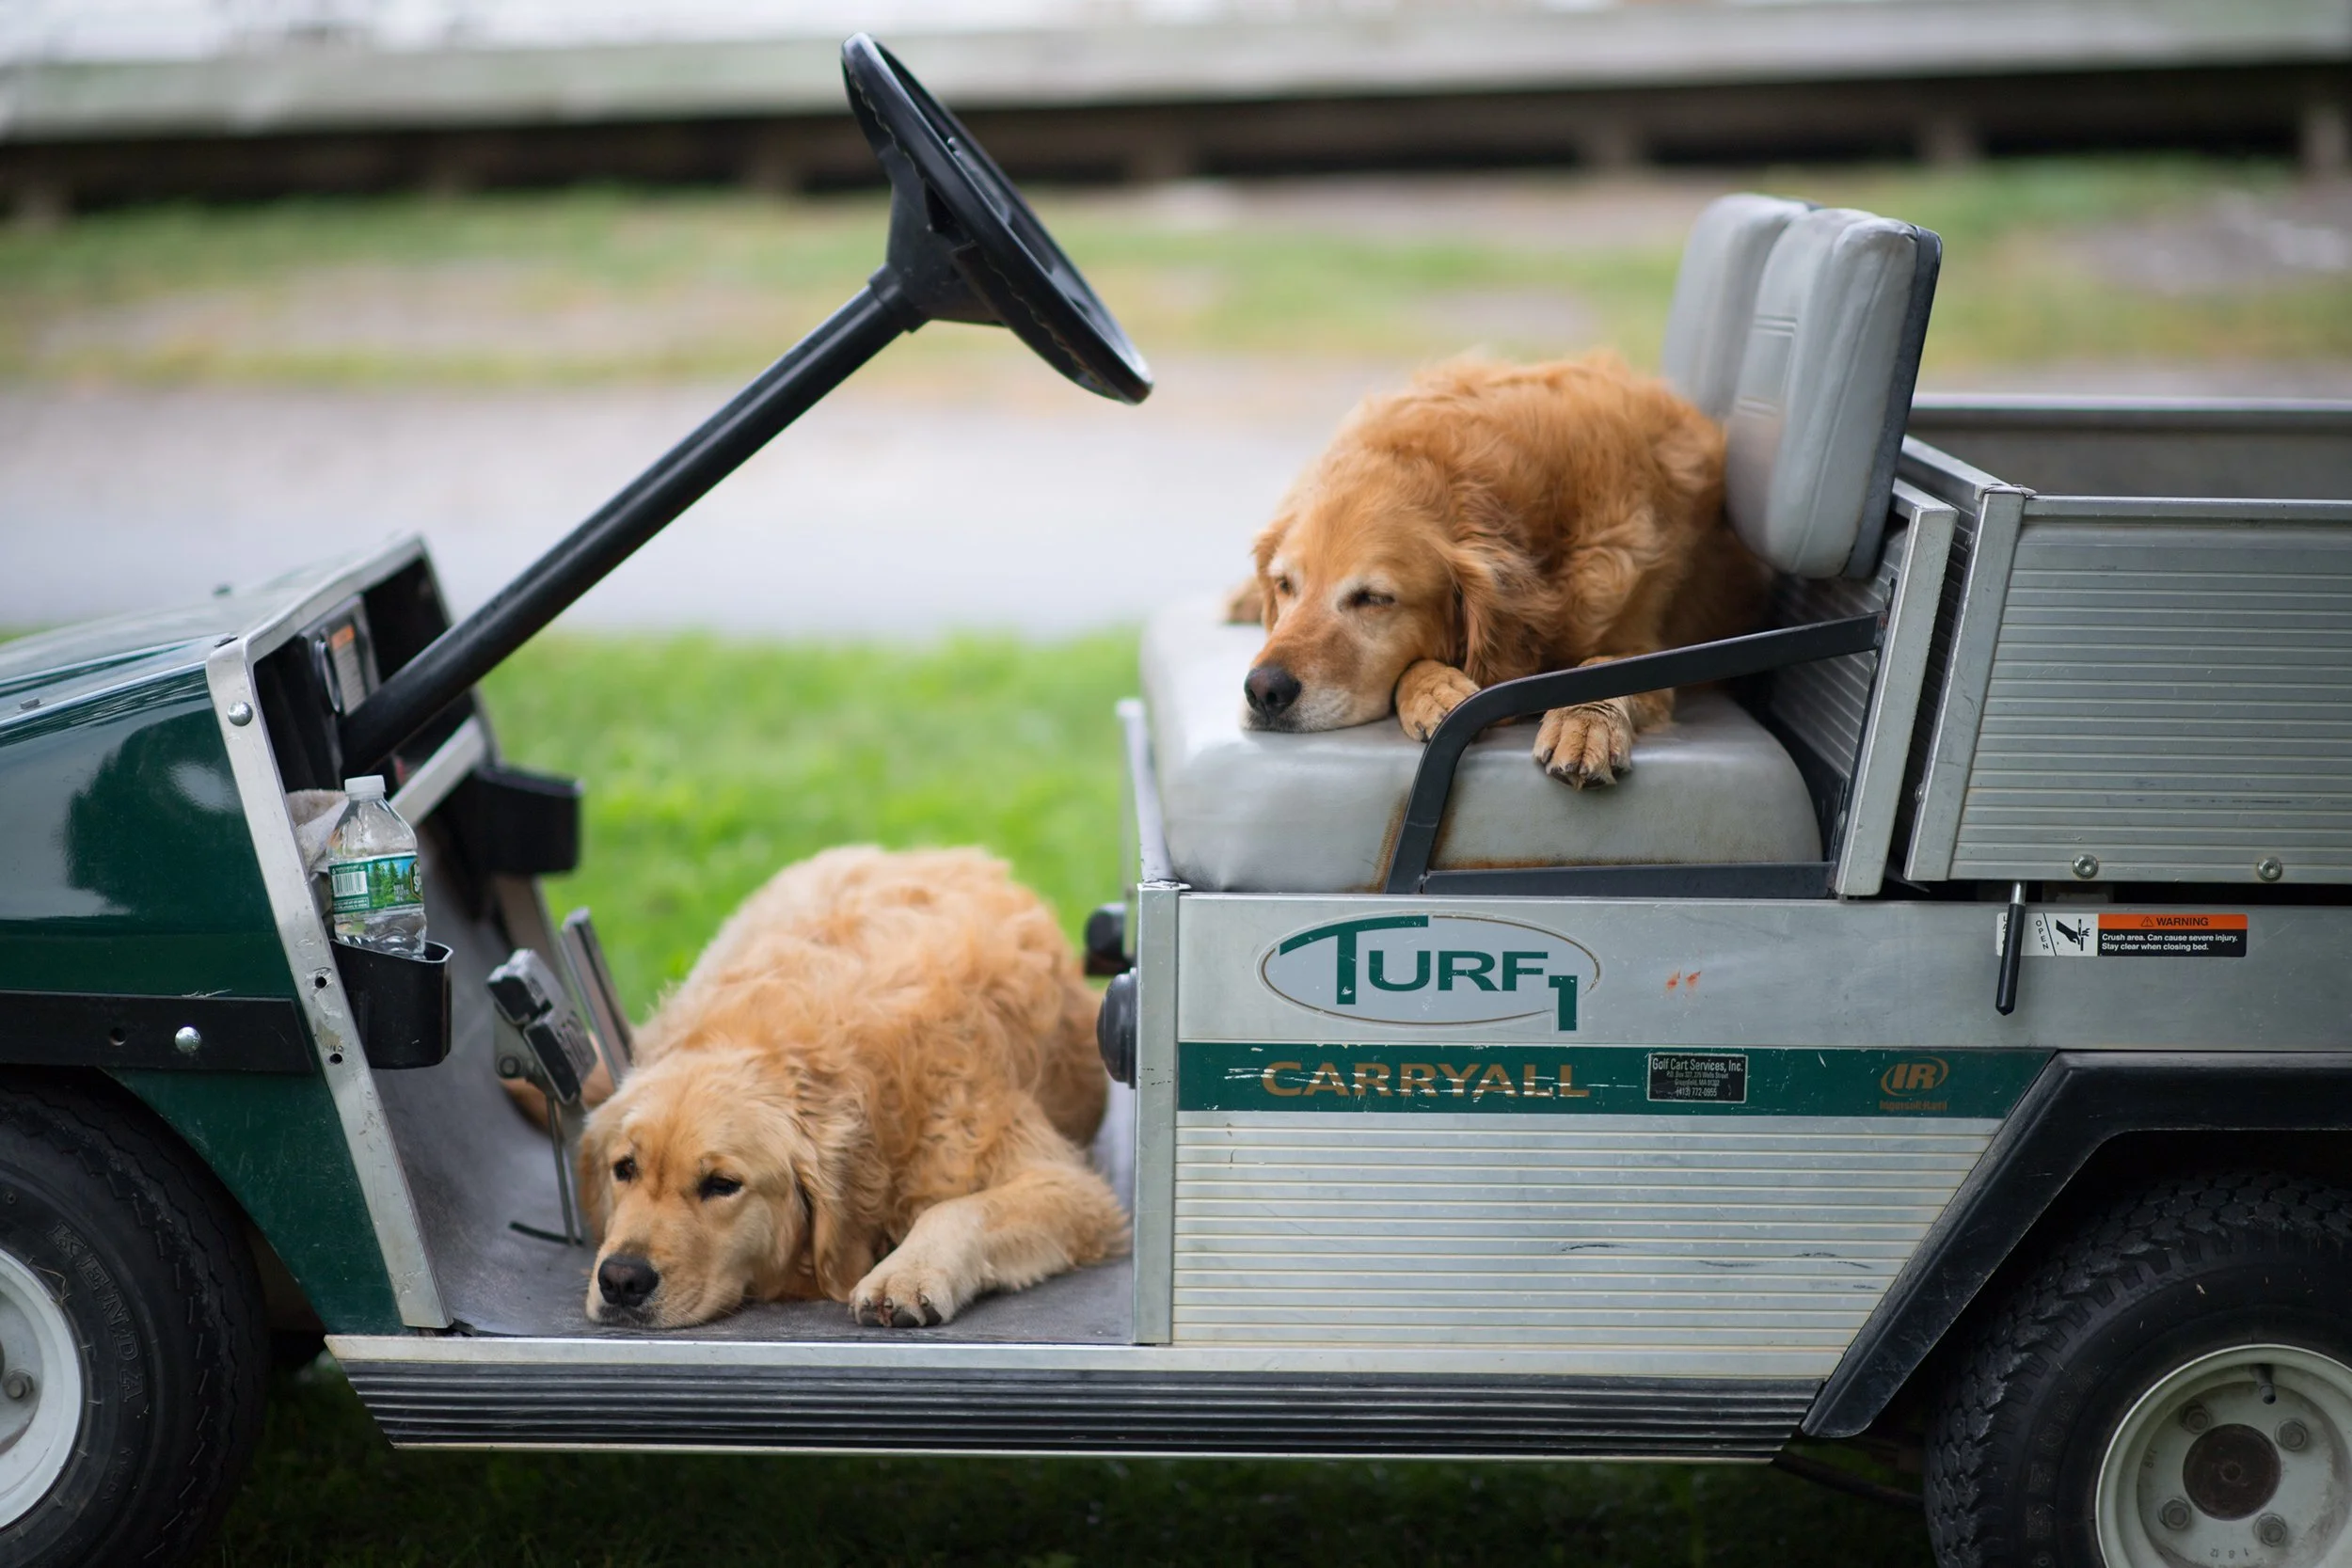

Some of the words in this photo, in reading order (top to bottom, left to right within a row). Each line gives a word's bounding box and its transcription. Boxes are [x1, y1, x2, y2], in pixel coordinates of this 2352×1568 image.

[2156, 917, 2209, 927] WARNING
[2035, 919, 2049, 950] OPEN
[2215, 933, 2238, 943] injury.
[2102, 942, 2120, 952] Stay
[2163, 942, 2191, 952] closing
[1652, 1057, 1669, 1070] Golf
[1670, 1058, 1689, 1070] Cart
[1690, 1058, 1727, 1073] Services,
[1728, 1059, 1744, 1071] Inc.
[1261, 1061, 1590, 1098] CARRYALL
[1891, 1064, 1937, 1089] IR
[44, 1218, 147, 1404] KENDA
